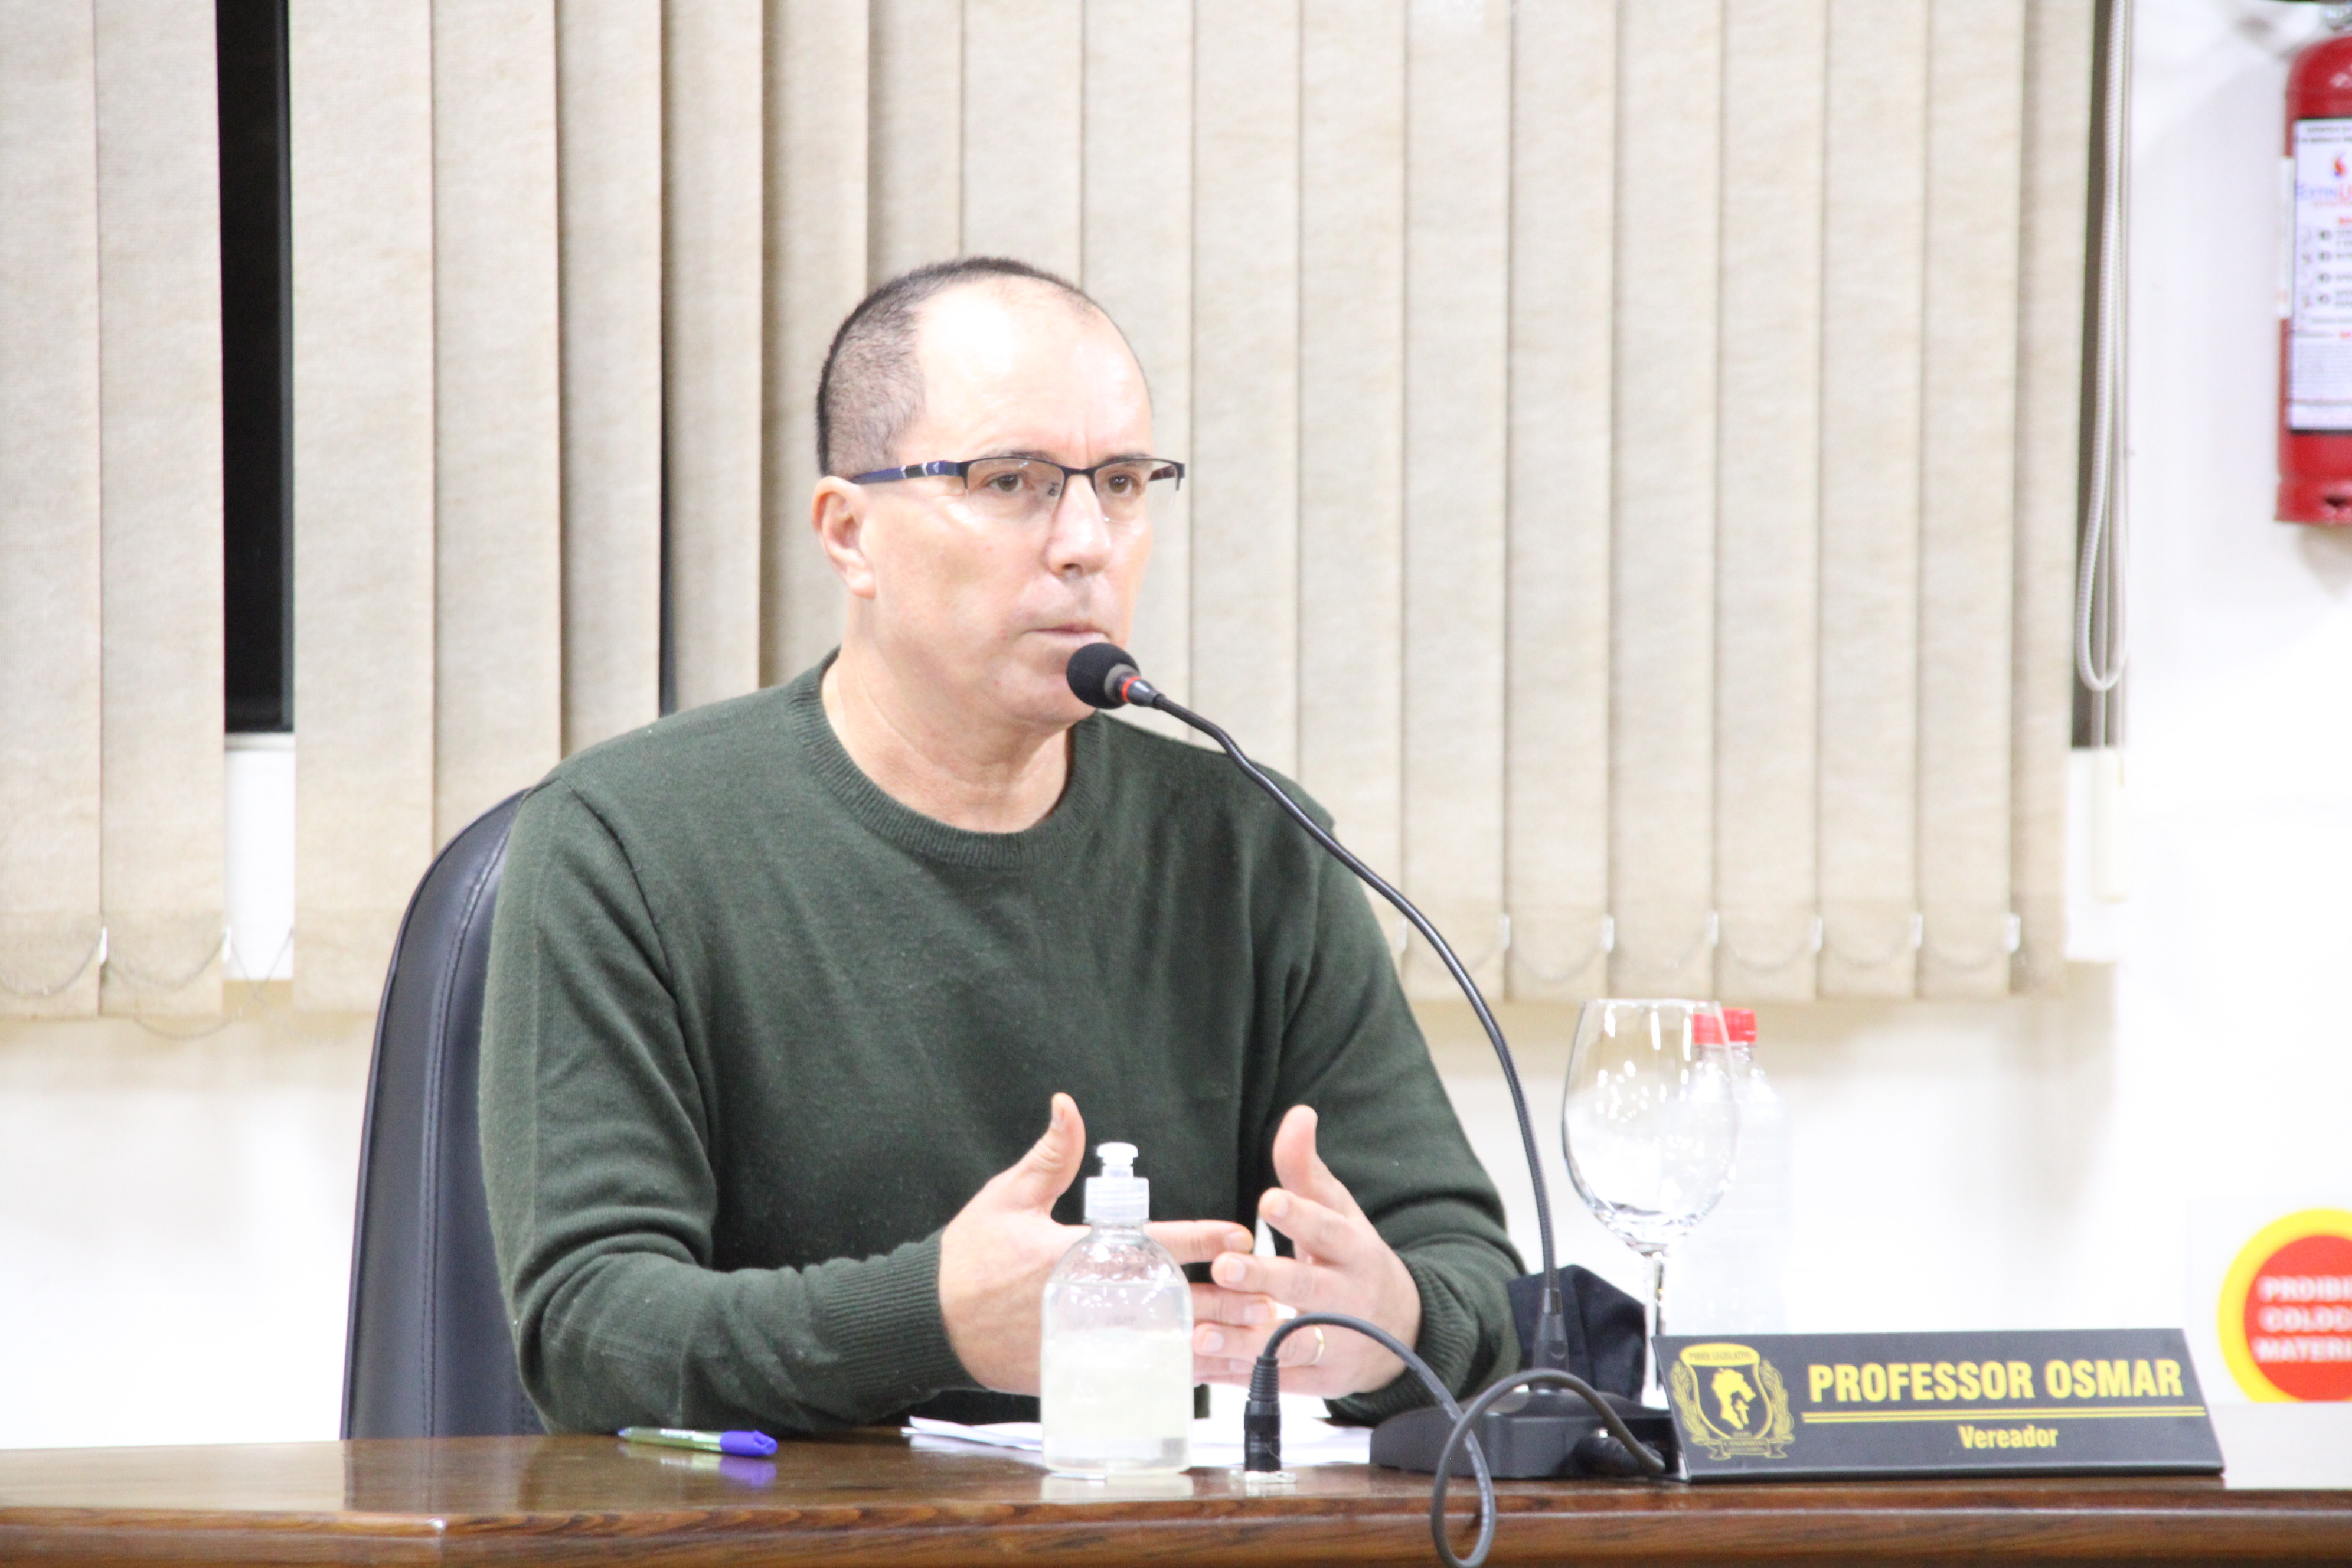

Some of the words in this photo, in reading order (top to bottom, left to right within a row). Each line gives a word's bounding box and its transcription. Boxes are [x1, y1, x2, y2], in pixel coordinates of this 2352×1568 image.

[1808, 1361, 2035, 1403] PROFESSOR
[2045, 1359, 2184, 1399] OSMAR
[1958, 1424, 2058, 1449] Vereador
